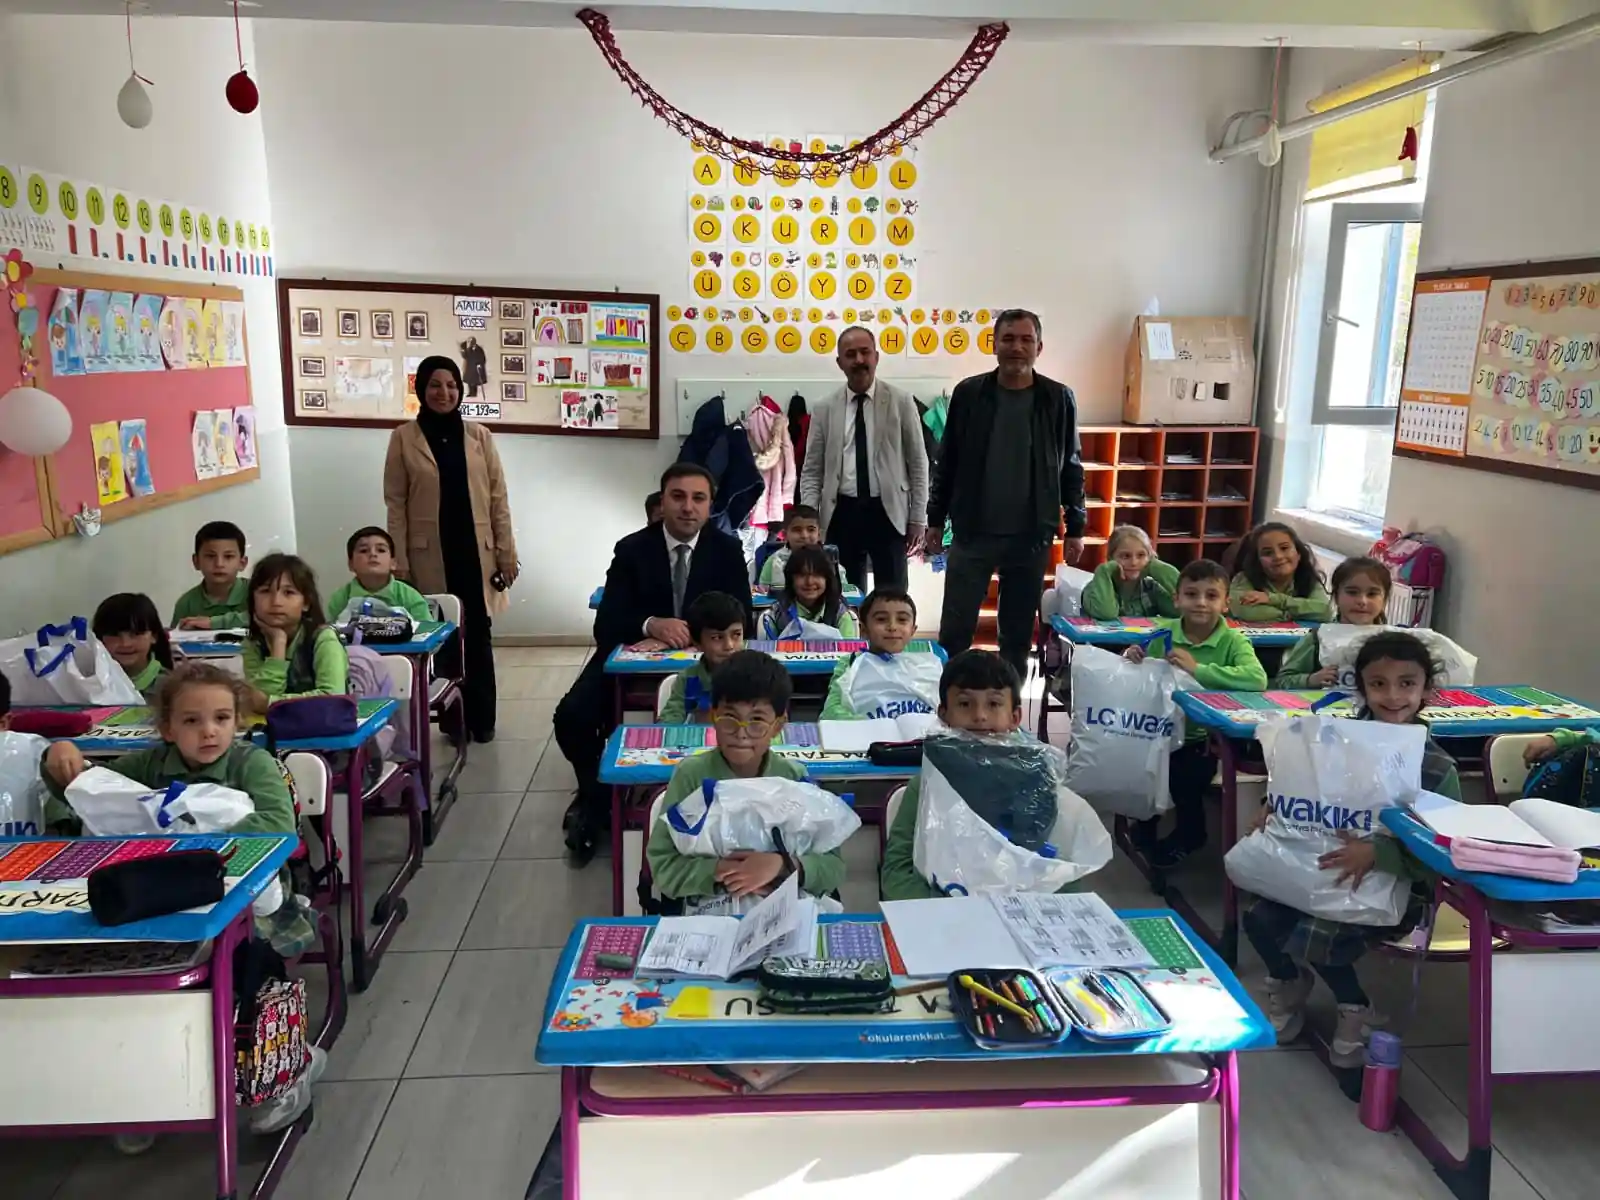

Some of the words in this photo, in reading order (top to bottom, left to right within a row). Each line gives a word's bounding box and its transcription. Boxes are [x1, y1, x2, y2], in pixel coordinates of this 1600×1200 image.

[701, 163, 713, 179] A
[898, 167, 908, 183] L
[0, 175, 10, 200] 8
[34, 183, 42, 206] 9
[62, 190, 75, 212] 10
[91, 195, 100, 219] 11
[116, 201, 128, 223] 12
[140, 207, 149, 227] 13
[161, 211, 172, 229] 14
[181, 216, 192, 234] 15
[202, 221, 210, 239] 16
[220, 223, 228, 241] 17
[700, 220, 715, 236] O
[742, 221, 752, 237] K
[780, 222, 792, 238] U
[820, 223, 829, 239] R
[893, 224, 908, 239] M
[701, 272, 713, 292] Ü
[742, 276, 752, 292] S
[777, 274, 791, 293] Ö
[817, 278, 829, 294] Y
[855, 278, 867, 294] D
[892, 279, 904, 294] Z
[1540, 295, 1546, 309] 5
[1549, 292, 1556, 307] 6
[1560, 288, 1567, 303] 7
[1579, 286, 1587, 301] 9
[676, 331, 689, 349] Ç
[715, 331, 724, 346] B
[747, 332, 762, 347] G
[782, 332, 794, 347] C
[818, 332, 827, 351] Ş
[886, 333, 898, 348] H
[919, 333, 932, 348] V
[949, 330, 964, 349] Ğ
[1549, 342, 1564, 365] 70
[1564, 340, 1579, 363] 80
[1580, 341, 1594, 362] 90
[1476, 369, 1486, 385] 5
[1503, 375, 1517, 394] 20
[1515, 380, 1529, 400] 25
[1539, 383, 1552, 403] 35
[1551, 390, 1564, 413] 40
[1565, 387, 1579, 409] 45
[1579, 388, 1593, 409] 50
[1511, 424, 1521, 441] 10
[1524, 424, 1533, 441] 12
[1569, 434, 1582, 454] 20
[1086, 706, 1116, 727] LC
